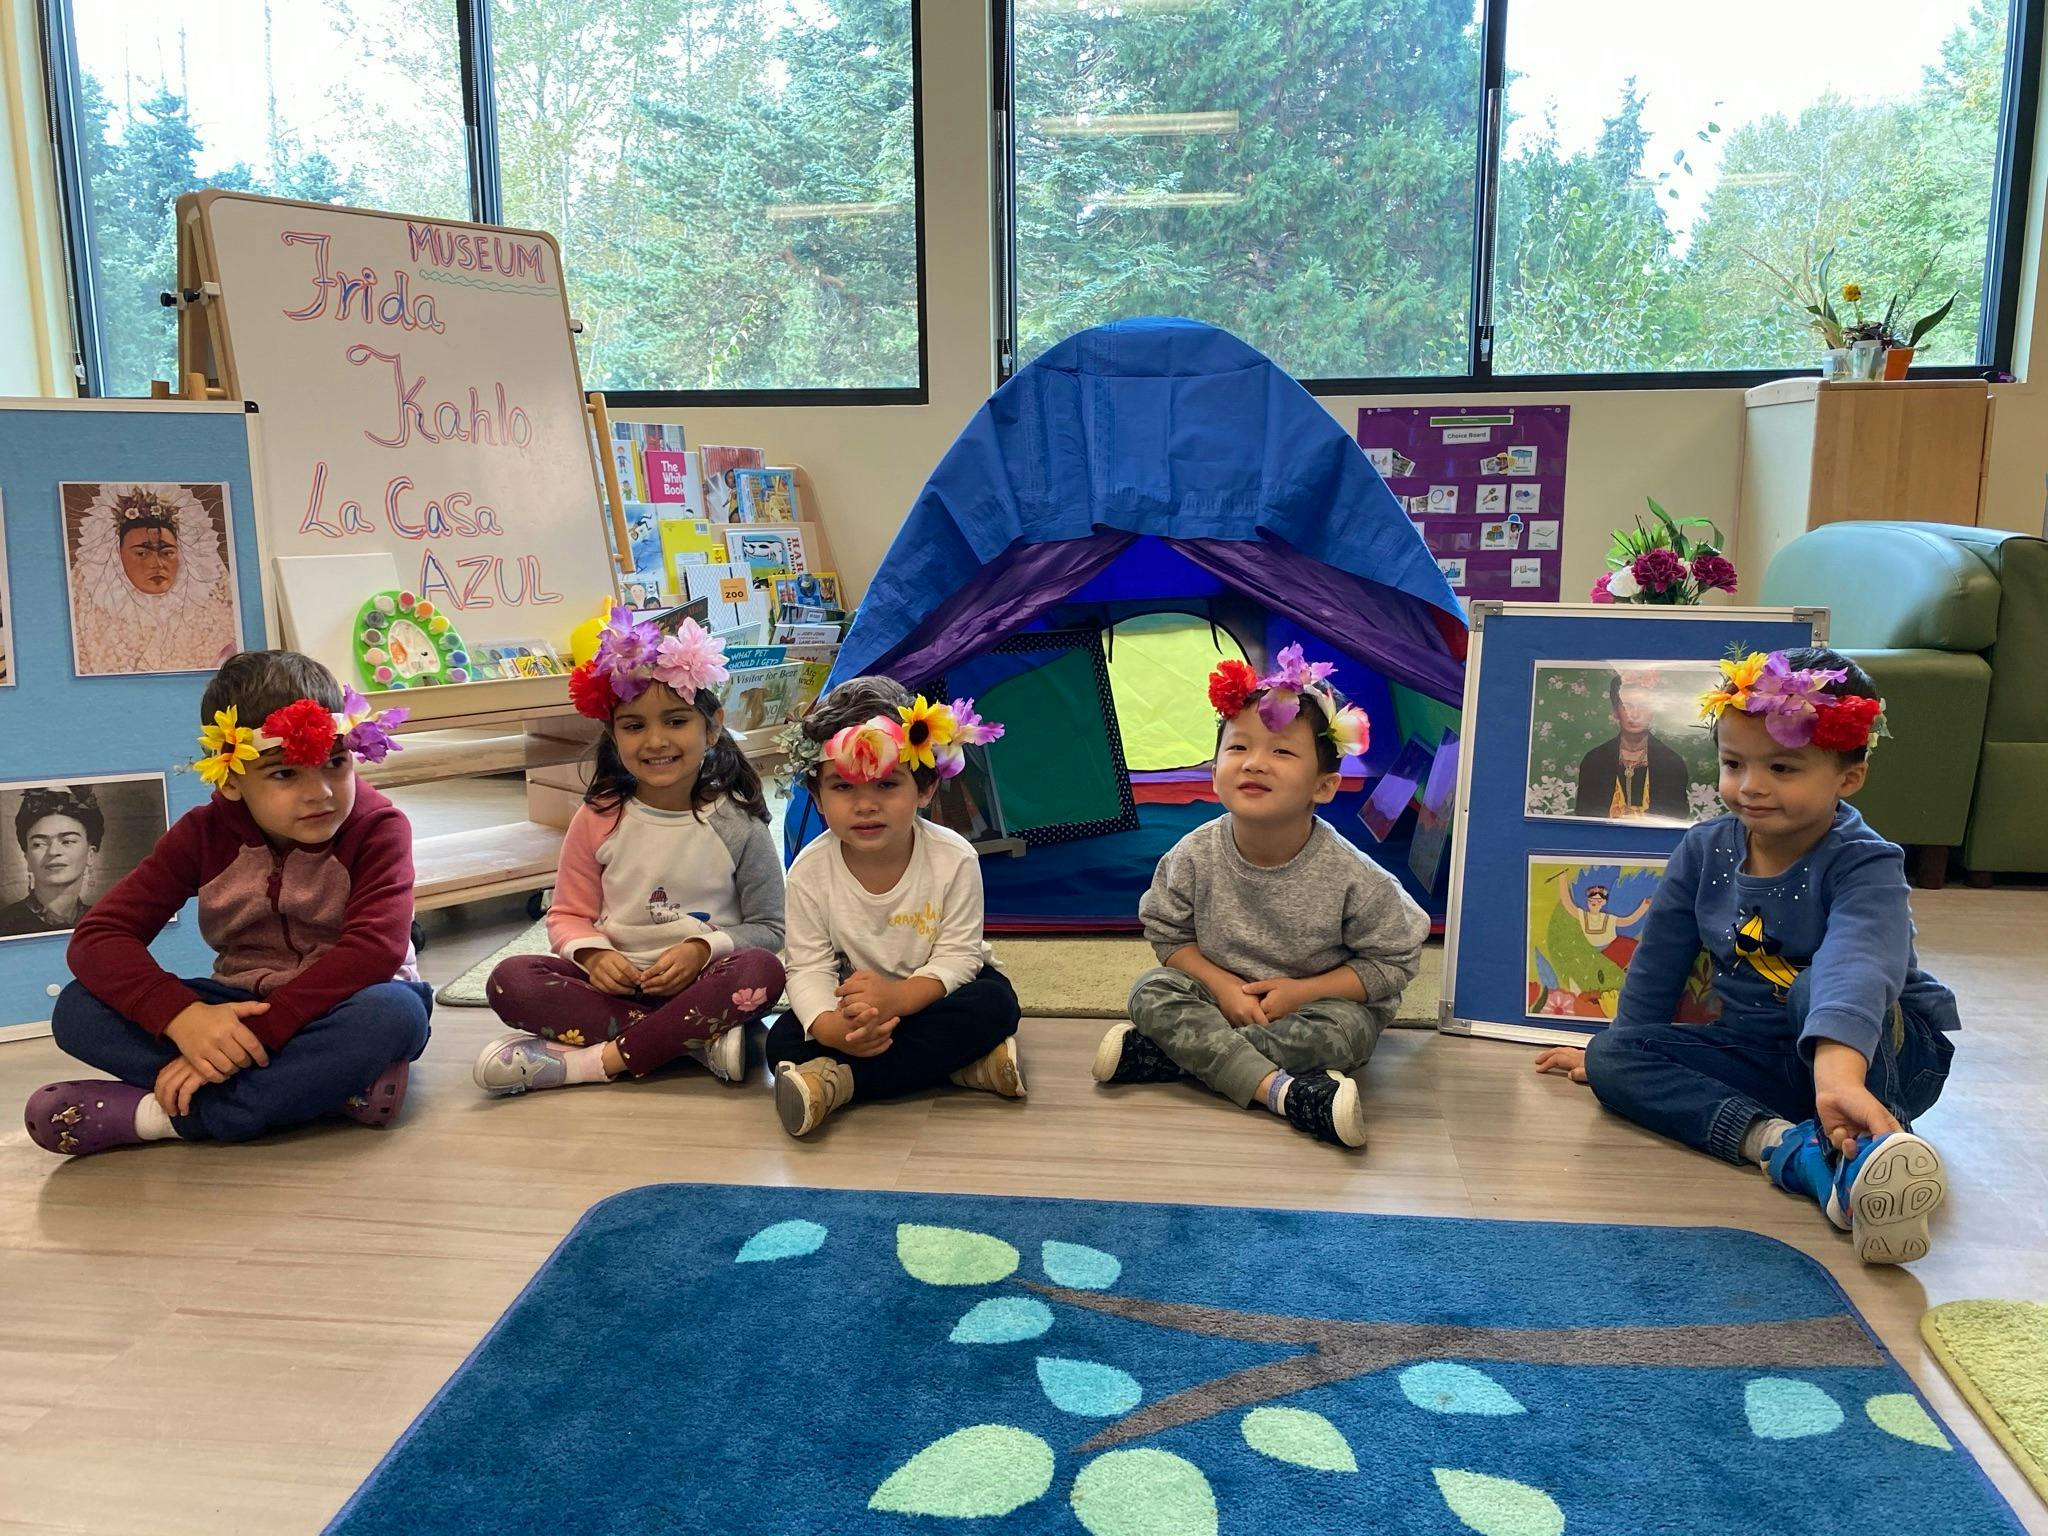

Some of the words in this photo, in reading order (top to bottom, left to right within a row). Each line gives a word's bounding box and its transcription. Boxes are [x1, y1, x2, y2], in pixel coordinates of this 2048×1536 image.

[281, 232, 445, 334] Frida
[407, 222, 545, 283] MUSEUM
[347, 344, 532, 448] Kahlo
[660, 460, 679, 472] The
[299, 462, 375, 538] La
[420, 548, 563, 611] AZUL
[728, 659, 755, 670] SHOULD
[731, 650, 752, 661] WHAT
[754, 649, 769, 658] PET
[737, 673, 764, 685] Visitor
[765, 671, 778, 680] for
[780, 669, 798, 678] Bear
